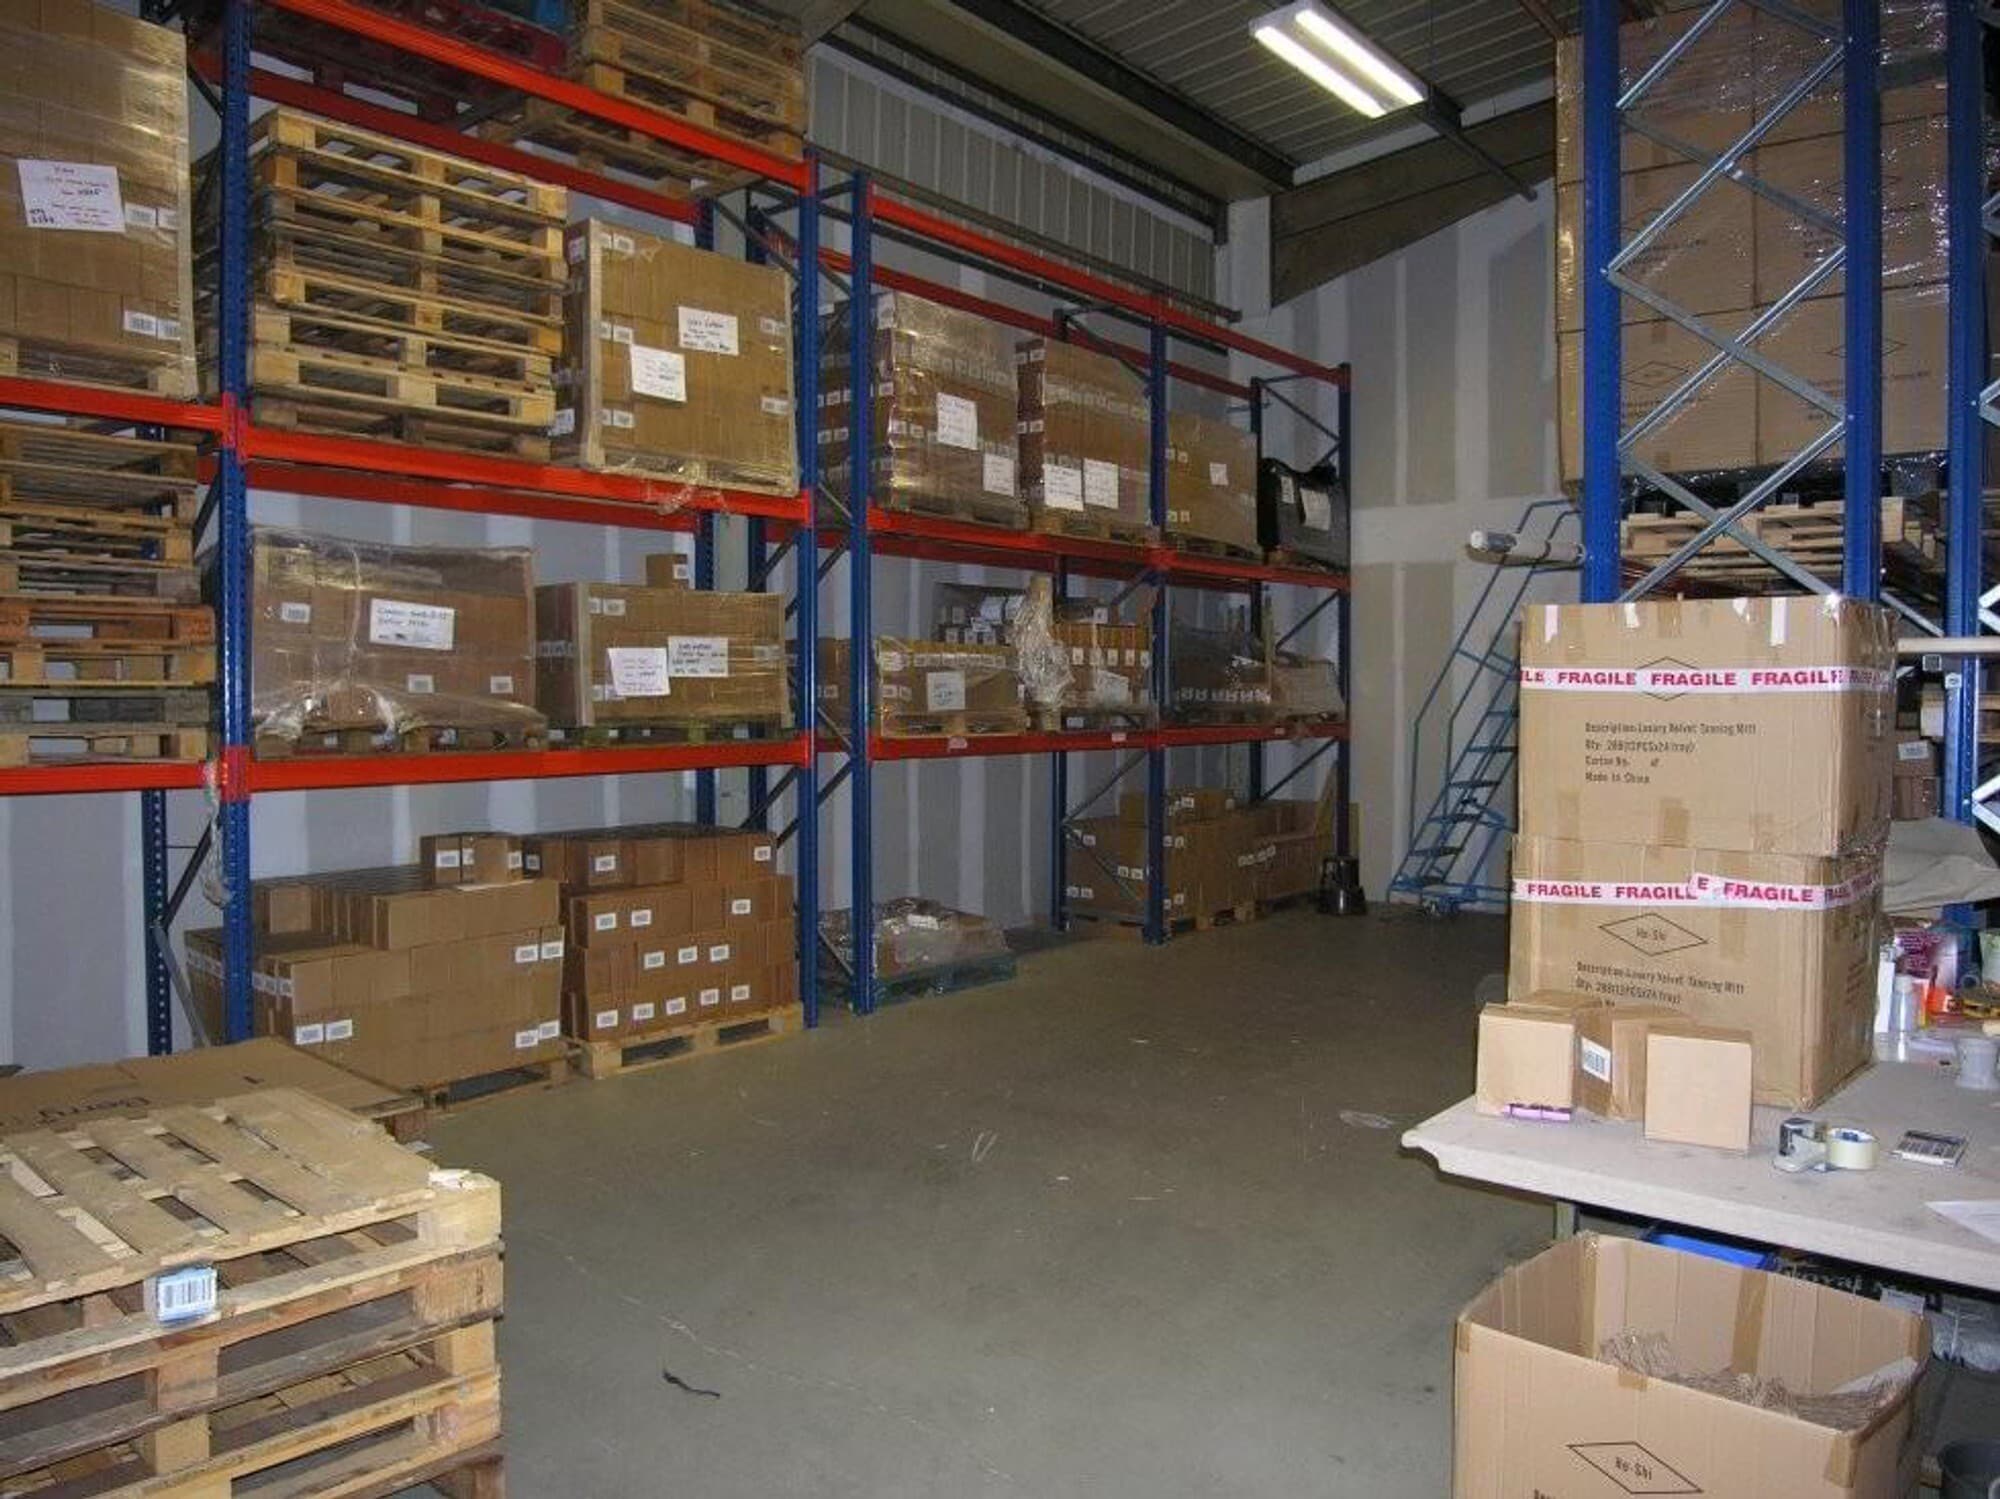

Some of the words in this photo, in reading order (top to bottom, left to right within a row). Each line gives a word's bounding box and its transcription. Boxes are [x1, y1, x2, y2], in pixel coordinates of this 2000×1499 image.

[1558, 671, 1636, 686] FRAGILE
[1651, 672, 1737, 687] FRAGILE
[1527, 883, 1601, 899] FRAGILE
[1723, 882, 1814, 903] FRAGILE
